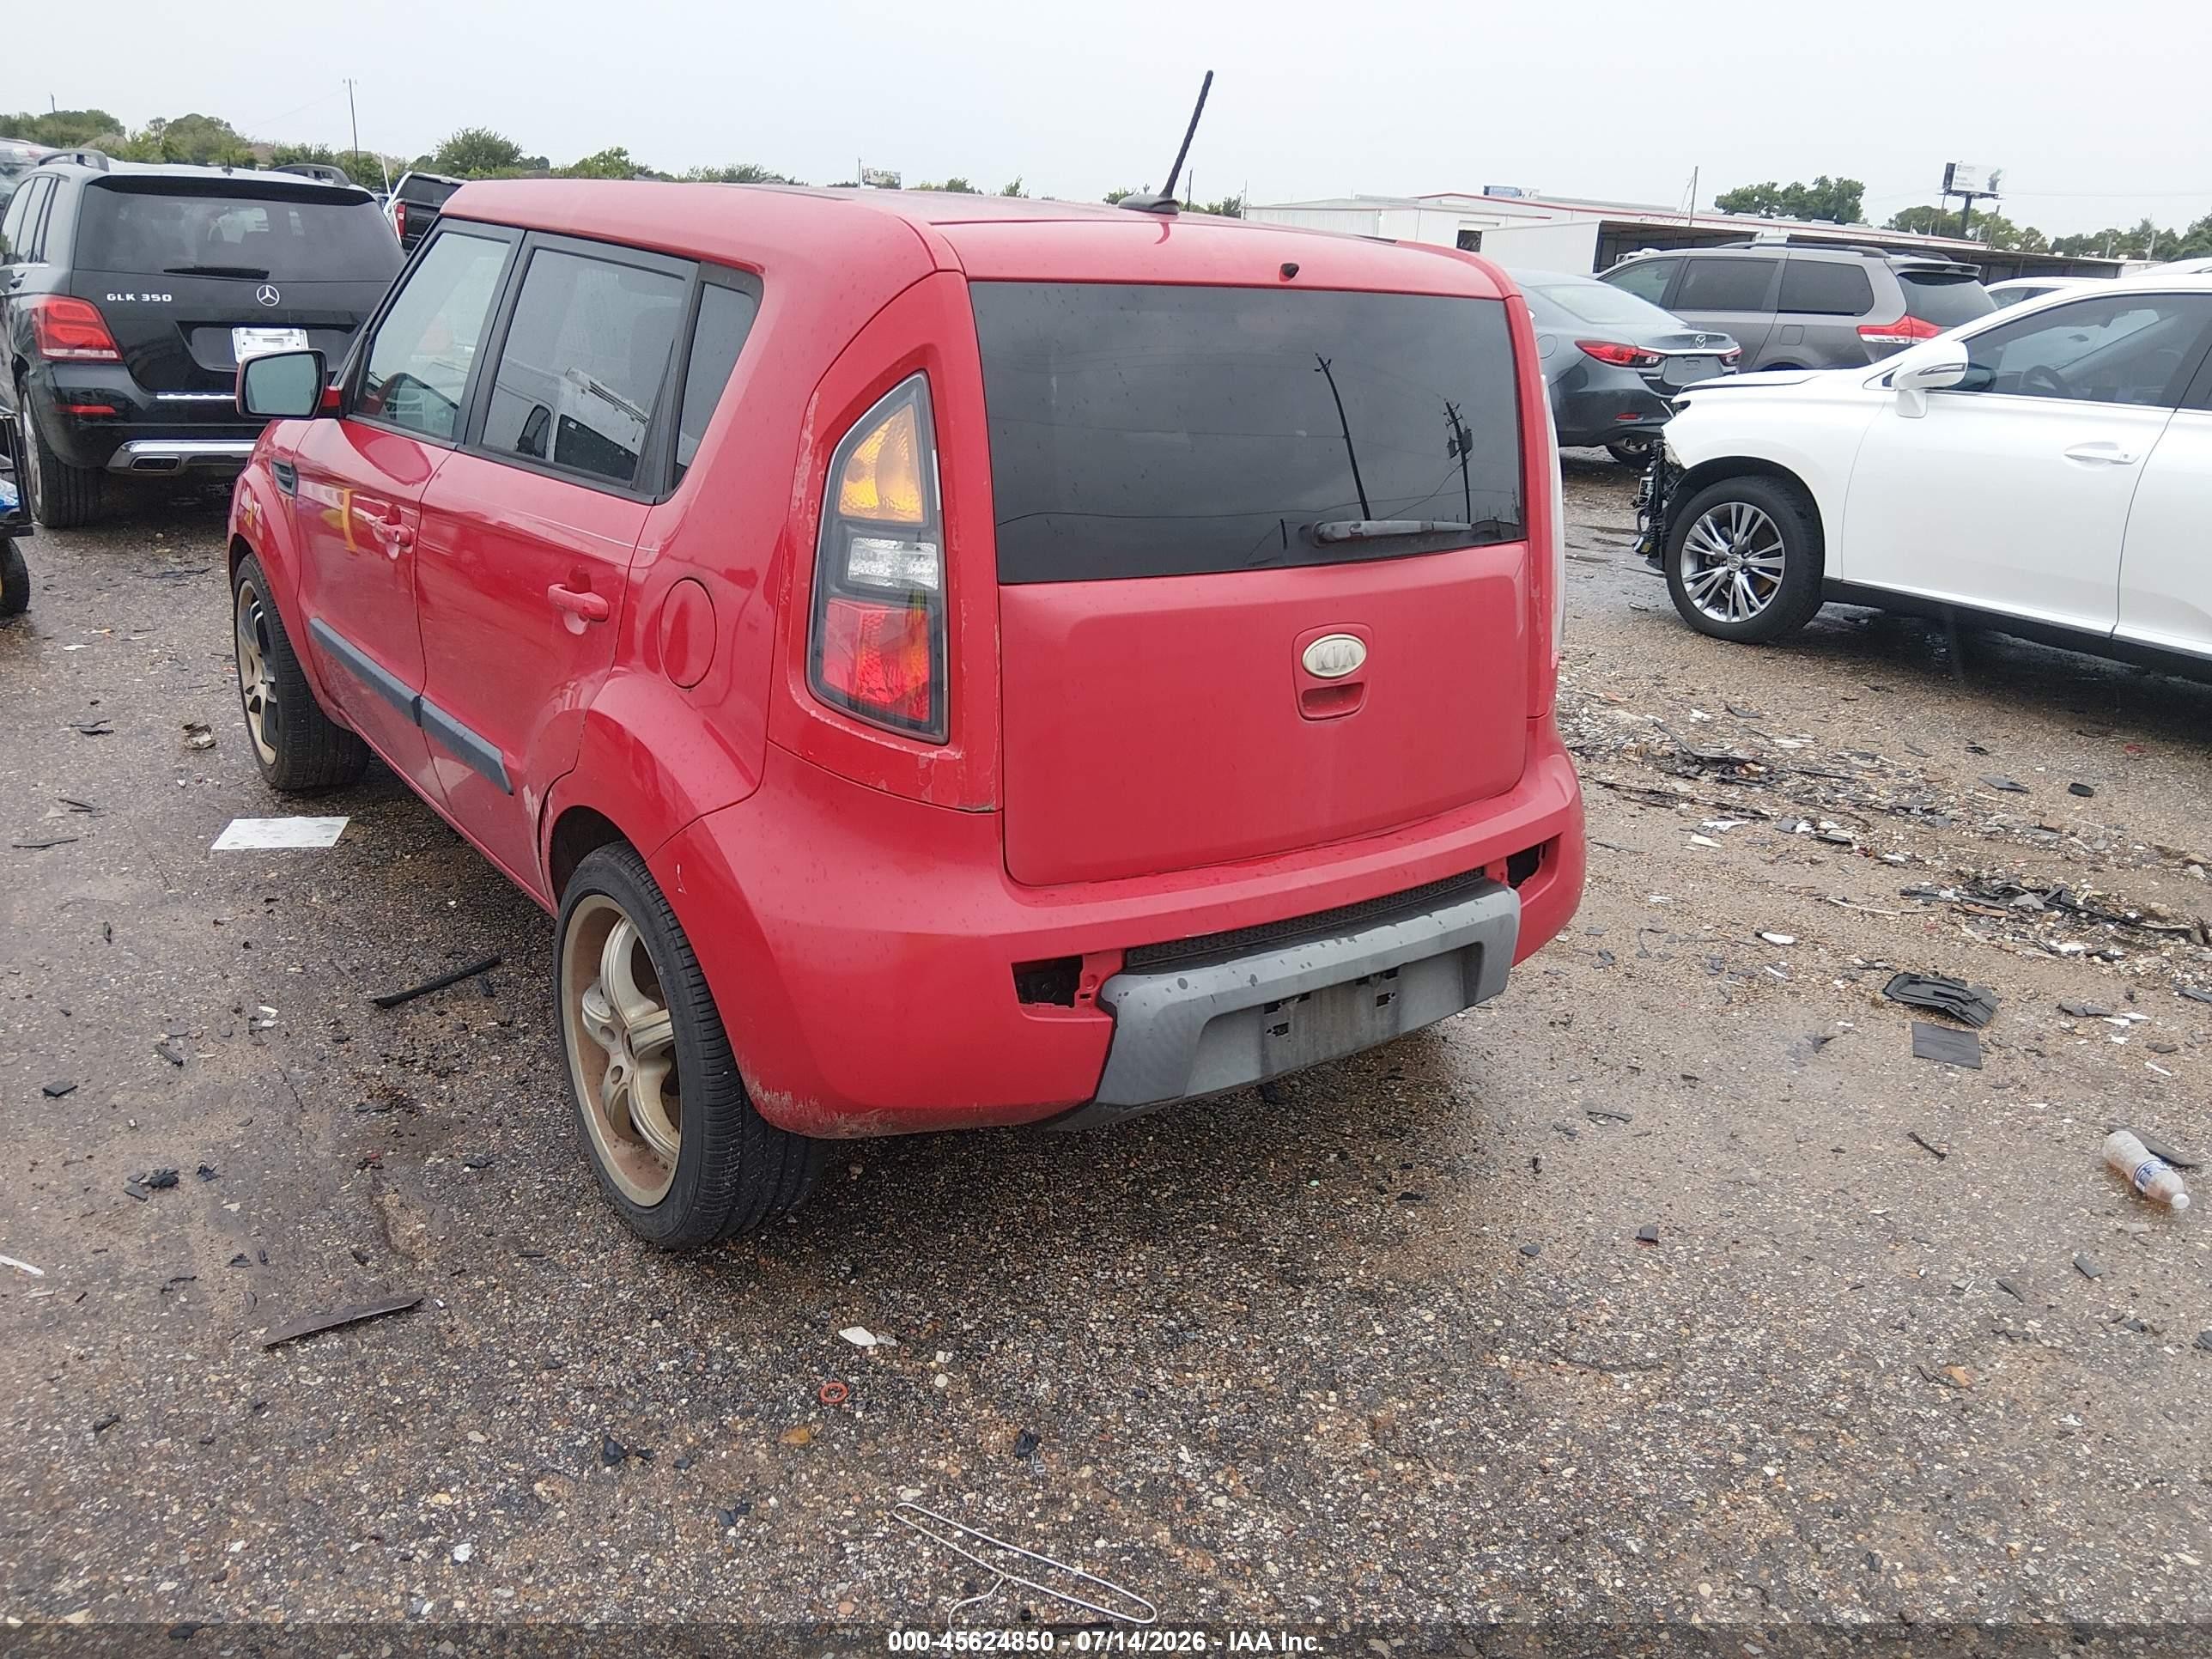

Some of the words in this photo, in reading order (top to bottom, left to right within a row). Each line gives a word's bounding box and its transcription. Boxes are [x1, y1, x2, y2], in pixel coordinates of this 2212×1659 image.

[106, 293, 137, 301] GLK
[141, 294, 173, 302] 350
[1314, 645, 1358, 670] KIA
